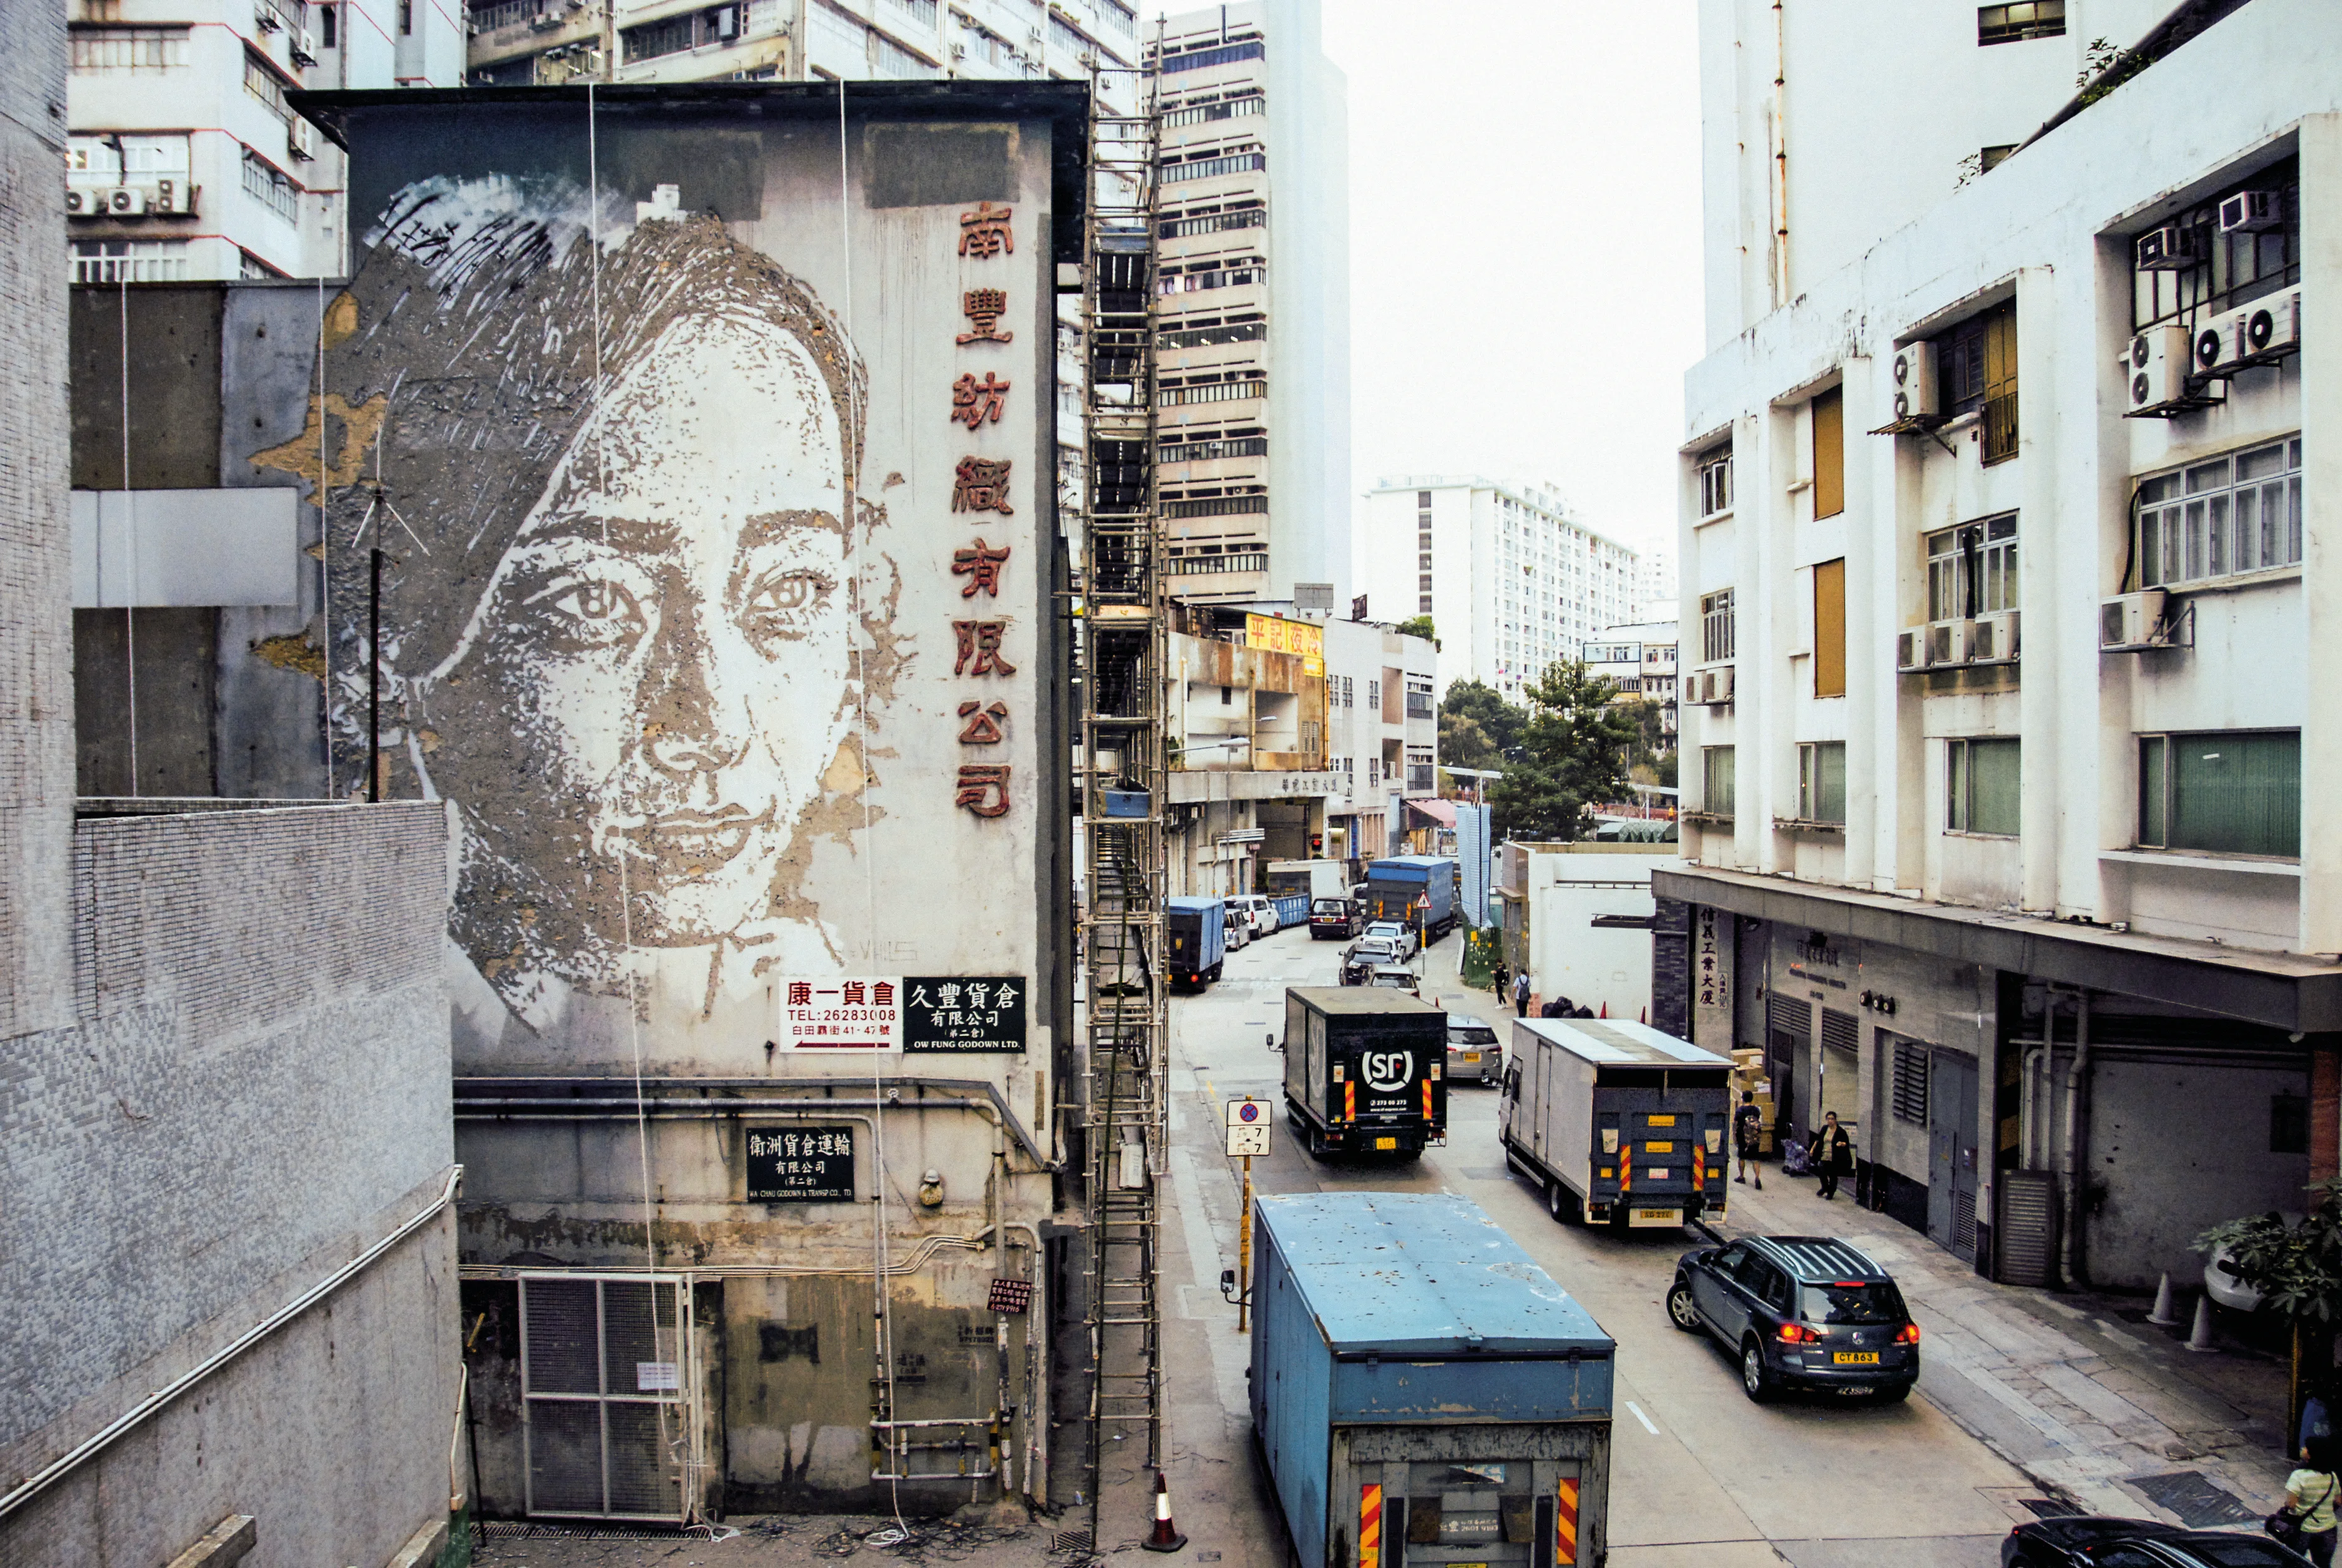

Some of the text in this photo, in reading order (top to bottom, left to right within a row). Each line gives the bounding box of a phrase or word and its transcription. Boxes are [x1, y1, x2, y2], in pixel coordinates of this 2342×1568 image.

[787, 981, 895, 1006] 康一貨倉
[909, 983, 1020, 1010] 久豐貨倉
[930, 1010, 999, 1027] 有限公司
[775, 1160, 825, 1175] 有限公司
[1853, 1353, 1873, 1361] 863
